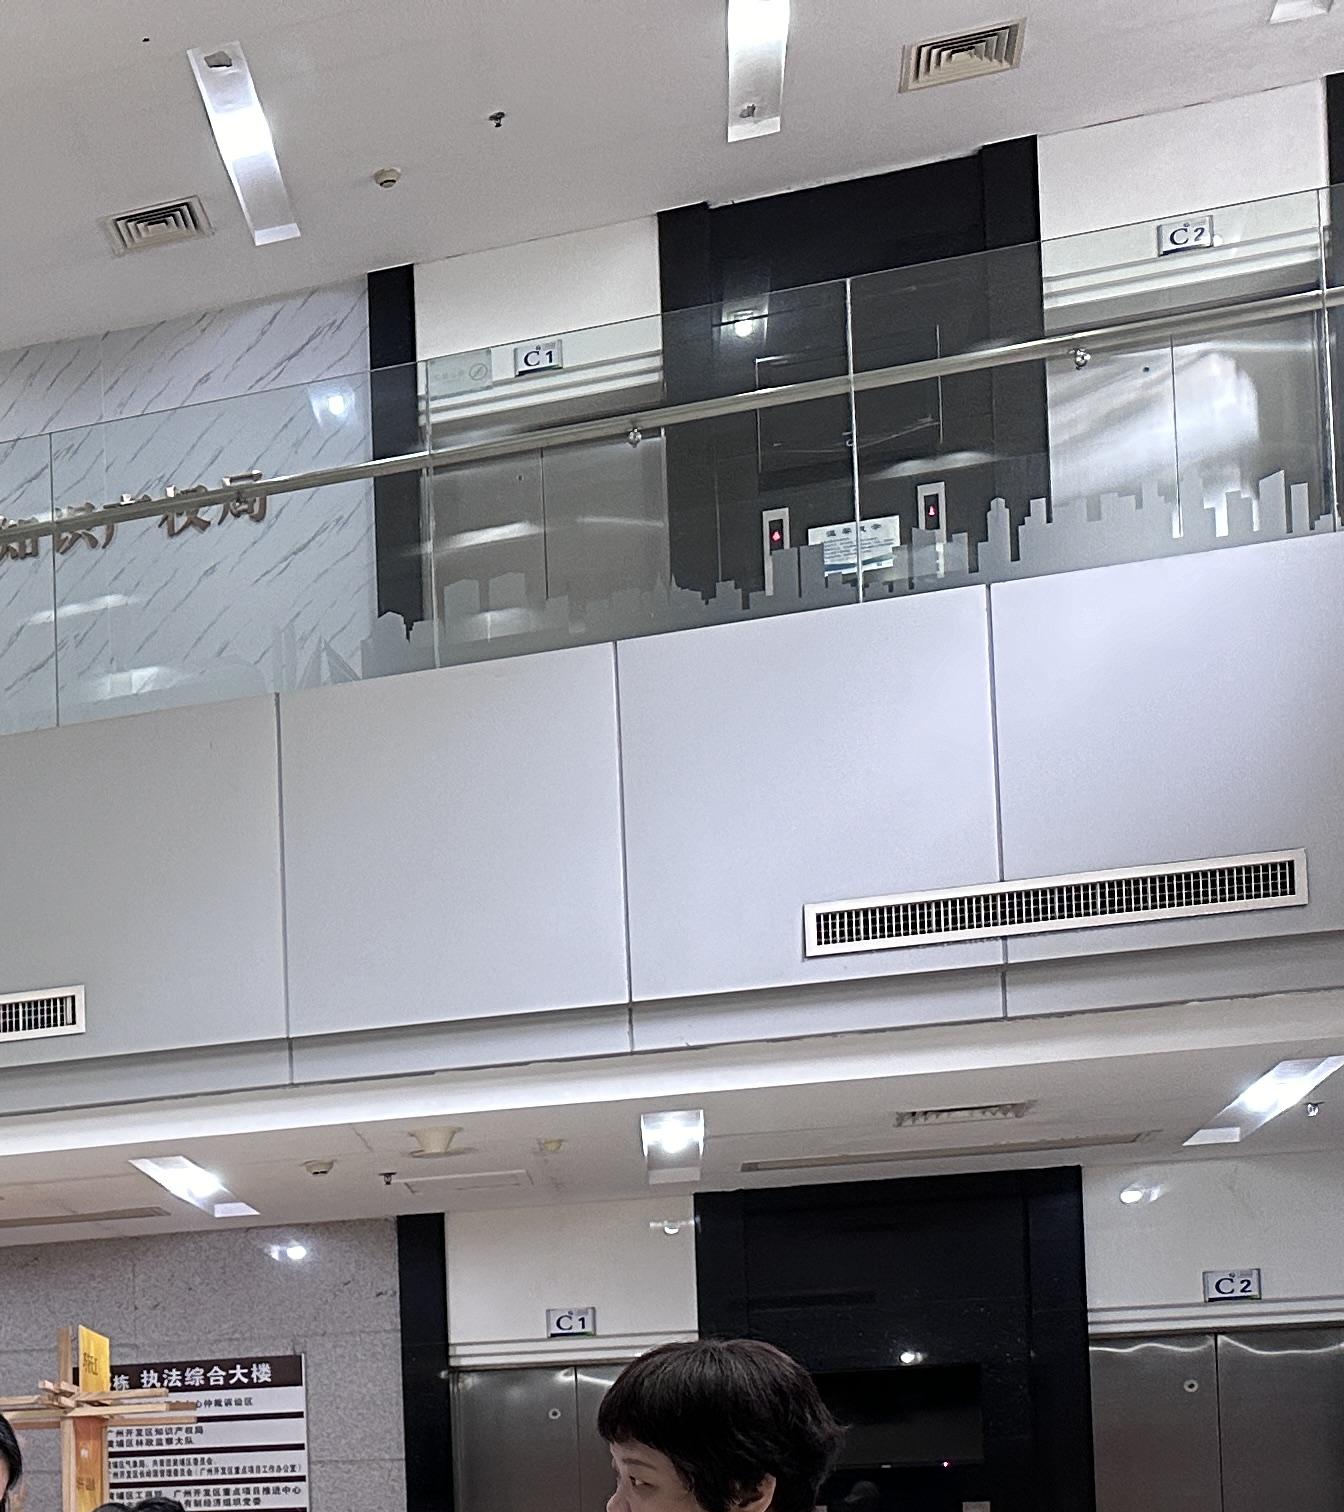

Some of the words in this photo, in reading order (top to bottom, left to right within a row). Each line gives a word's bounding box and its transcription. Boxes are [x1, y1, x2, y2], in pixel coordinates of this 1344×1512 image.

[140, 1362, 273, 1389] 执法综合大楼
